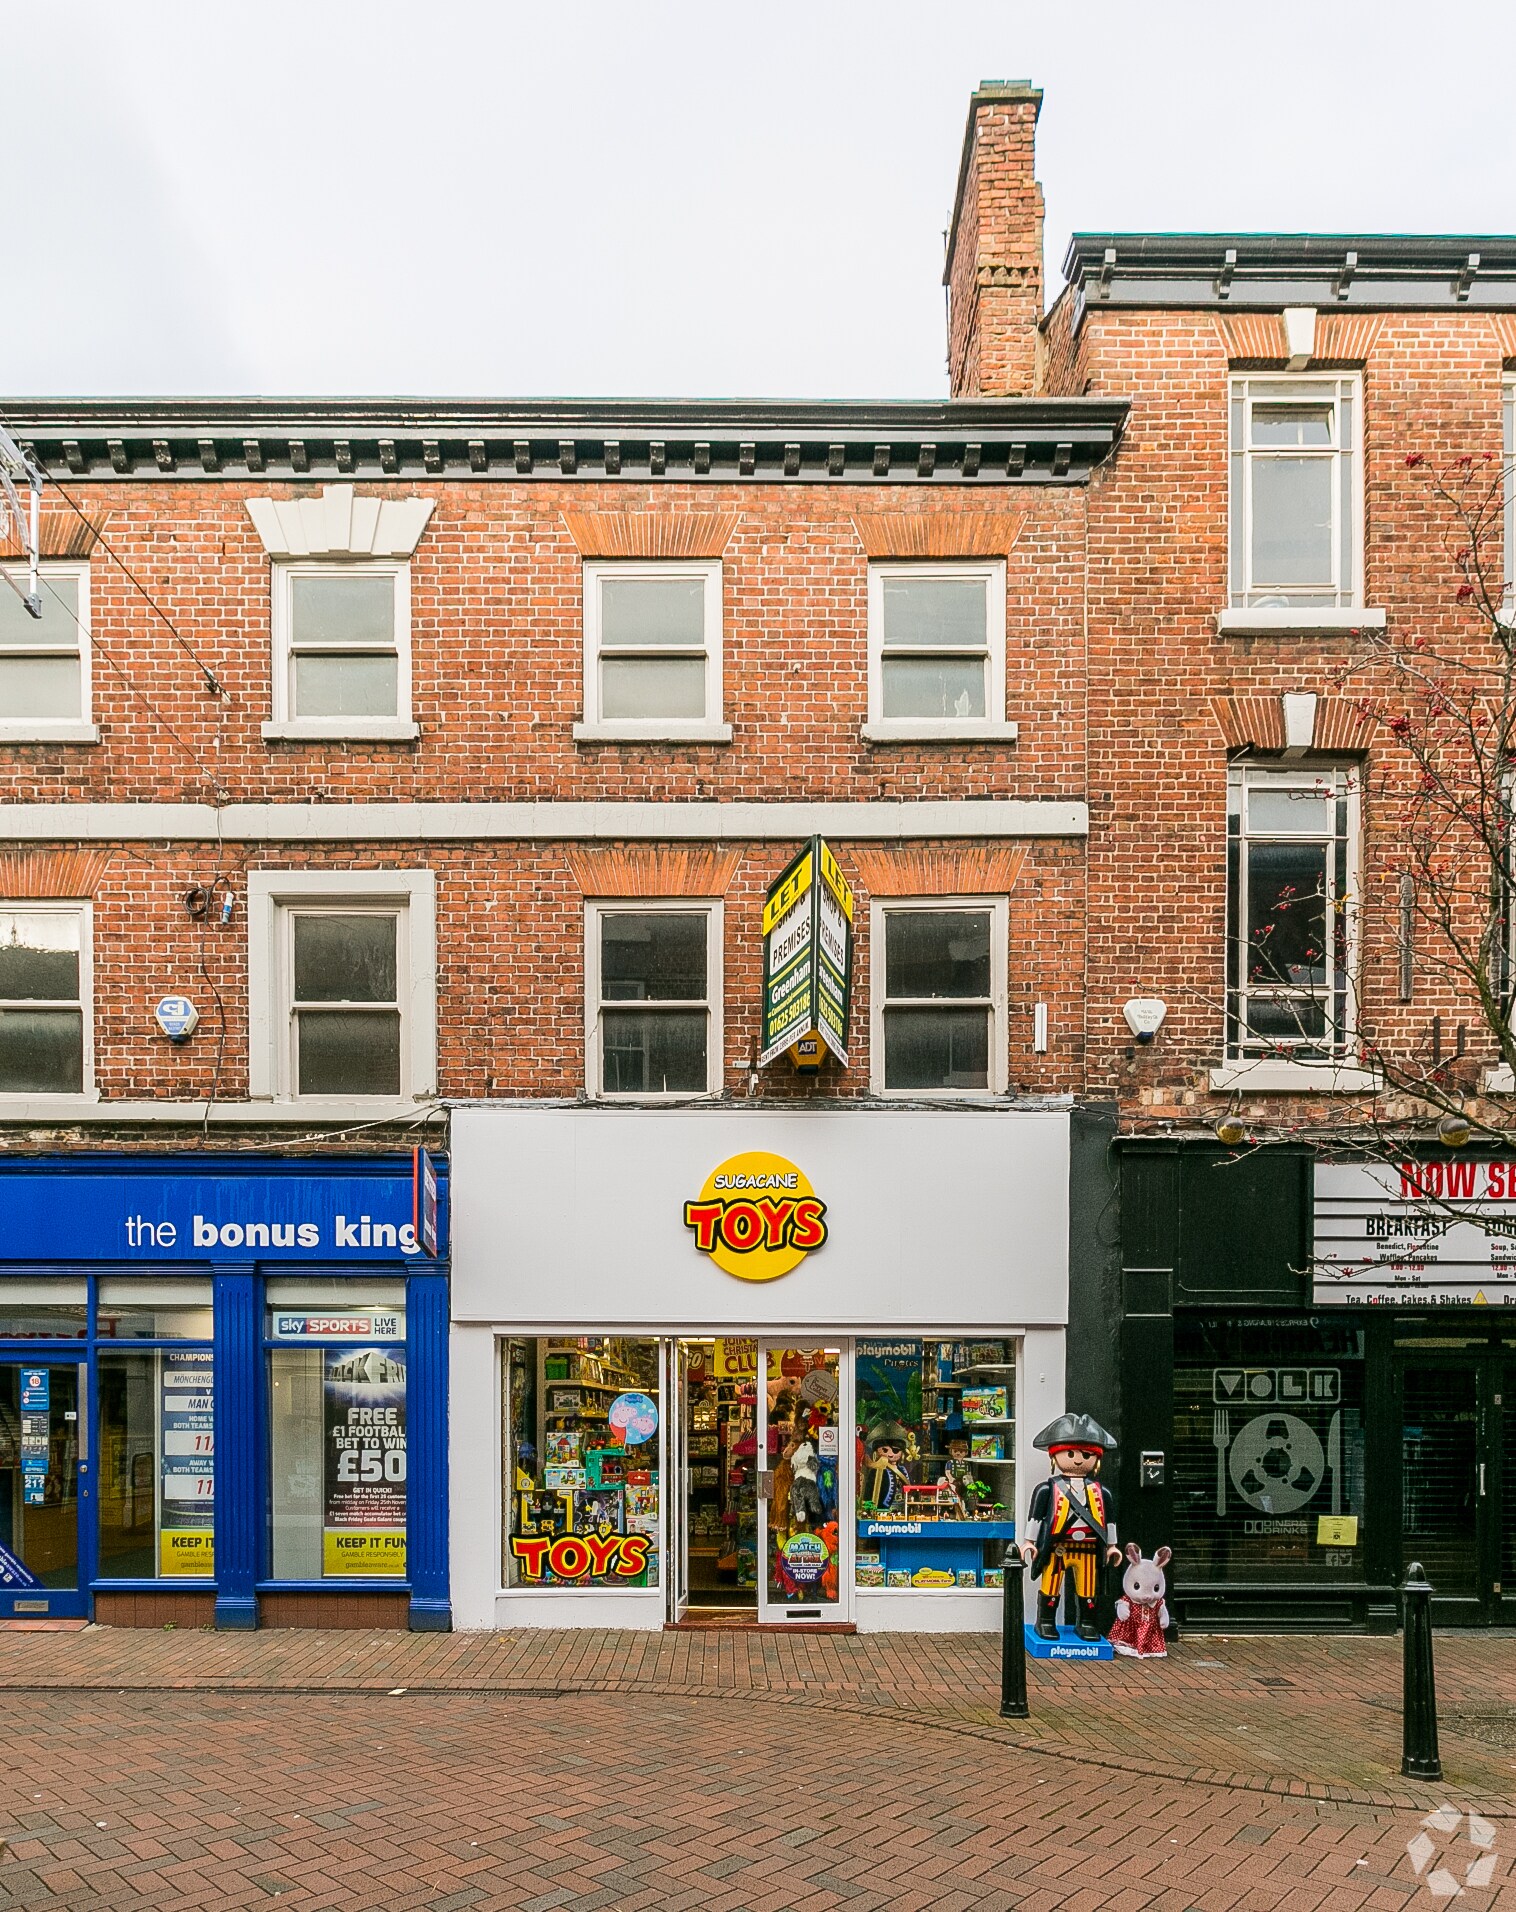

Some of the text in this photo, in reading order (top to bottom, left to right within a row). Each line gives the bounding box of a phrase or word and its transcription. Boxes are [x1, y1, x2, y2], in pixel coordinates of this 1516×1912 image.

[828, 855, 848, 904] LET
[771, 867, 802, 920] LET
[823, 884, 837, 917] SHOP
[772, 916, 810, 967] PREMISES
[771, 961, 811, 1004] Greenham
[769, 1008, 789, 1037] 01625
[798, 1041, 817, 1053] ADT
[714, 1173, 798, 1189] SUGACANE
[1400, 1162, 1477, 1198] NOW
[685, 1197, 827, 1252] TOYS
[125, 1215, 176, 1247] the
[193, 1215, 320, 1247] bonus
[335, 1215, 421, 1254] king
[1376, 1243, 1406, 1251] Benedict,
[1491, 1243, 1509, 1251] Soup,
[1408, 1253, 1438, 1261] Pancakes
[1439, 1294, 1472, 1304] Shakes
[280, 1318, 397, 1334] sky SPORTS LIVE
[374, 1327, 397, 1335] HERE
[856, 1343, 916, 1358] playmobil
[187, 1399, 208, 1409] MAN
[347, 1407, 398, 1425] FREE
[332, 1426, 345, 1437] £1
[336, 1438, 406, 1449] BET TO WIN
[337, 1450, 407, 1482] £50
[867, 1522, 922, 1536] playmobil
[1263, 1526, 1308, 1534] DRINKS
[171, 1537, 203, 1548] KEEP
[336, 1537, 406, 1549] KEEP IT FUN
[789, 1543, 821, 1554] MATCH
[511, 1534, 651, 1578] TOYS
[1050, 1646, 1099, 1657] playmobil
